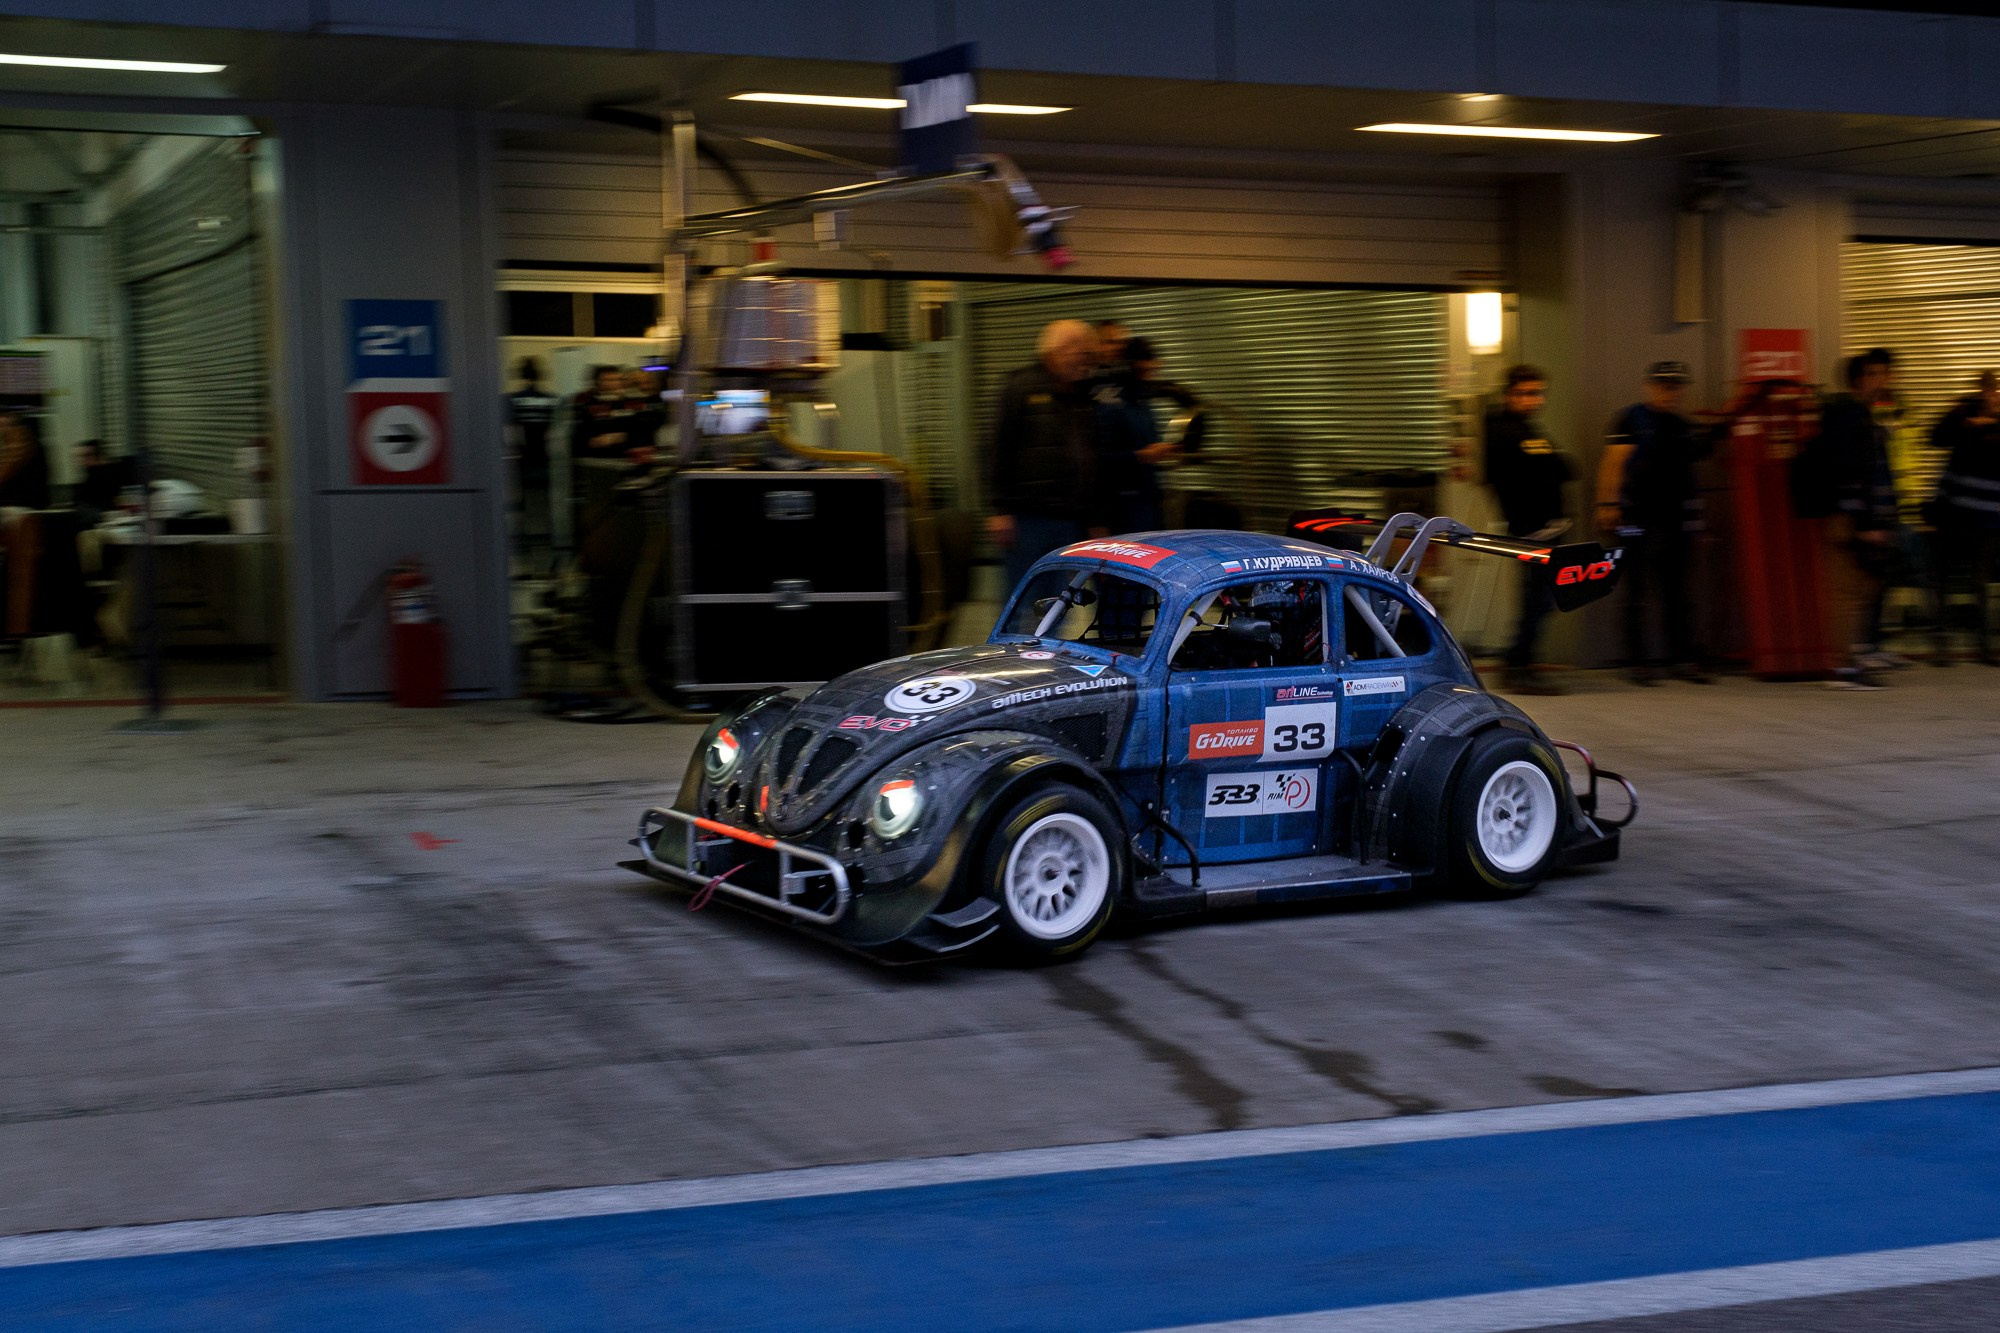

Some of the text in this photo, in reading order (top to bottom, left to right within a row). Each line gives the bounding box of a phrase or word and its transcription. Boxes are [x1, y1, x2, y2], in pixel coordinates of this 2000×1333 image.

[358, 325, 432, 356] 21
[1556, 561, 1613, 585] EVO
[902, 682, 954, 705] 33
[838, 715, 913, 732] EVO
[1273, 722, 1326, 753] 33
